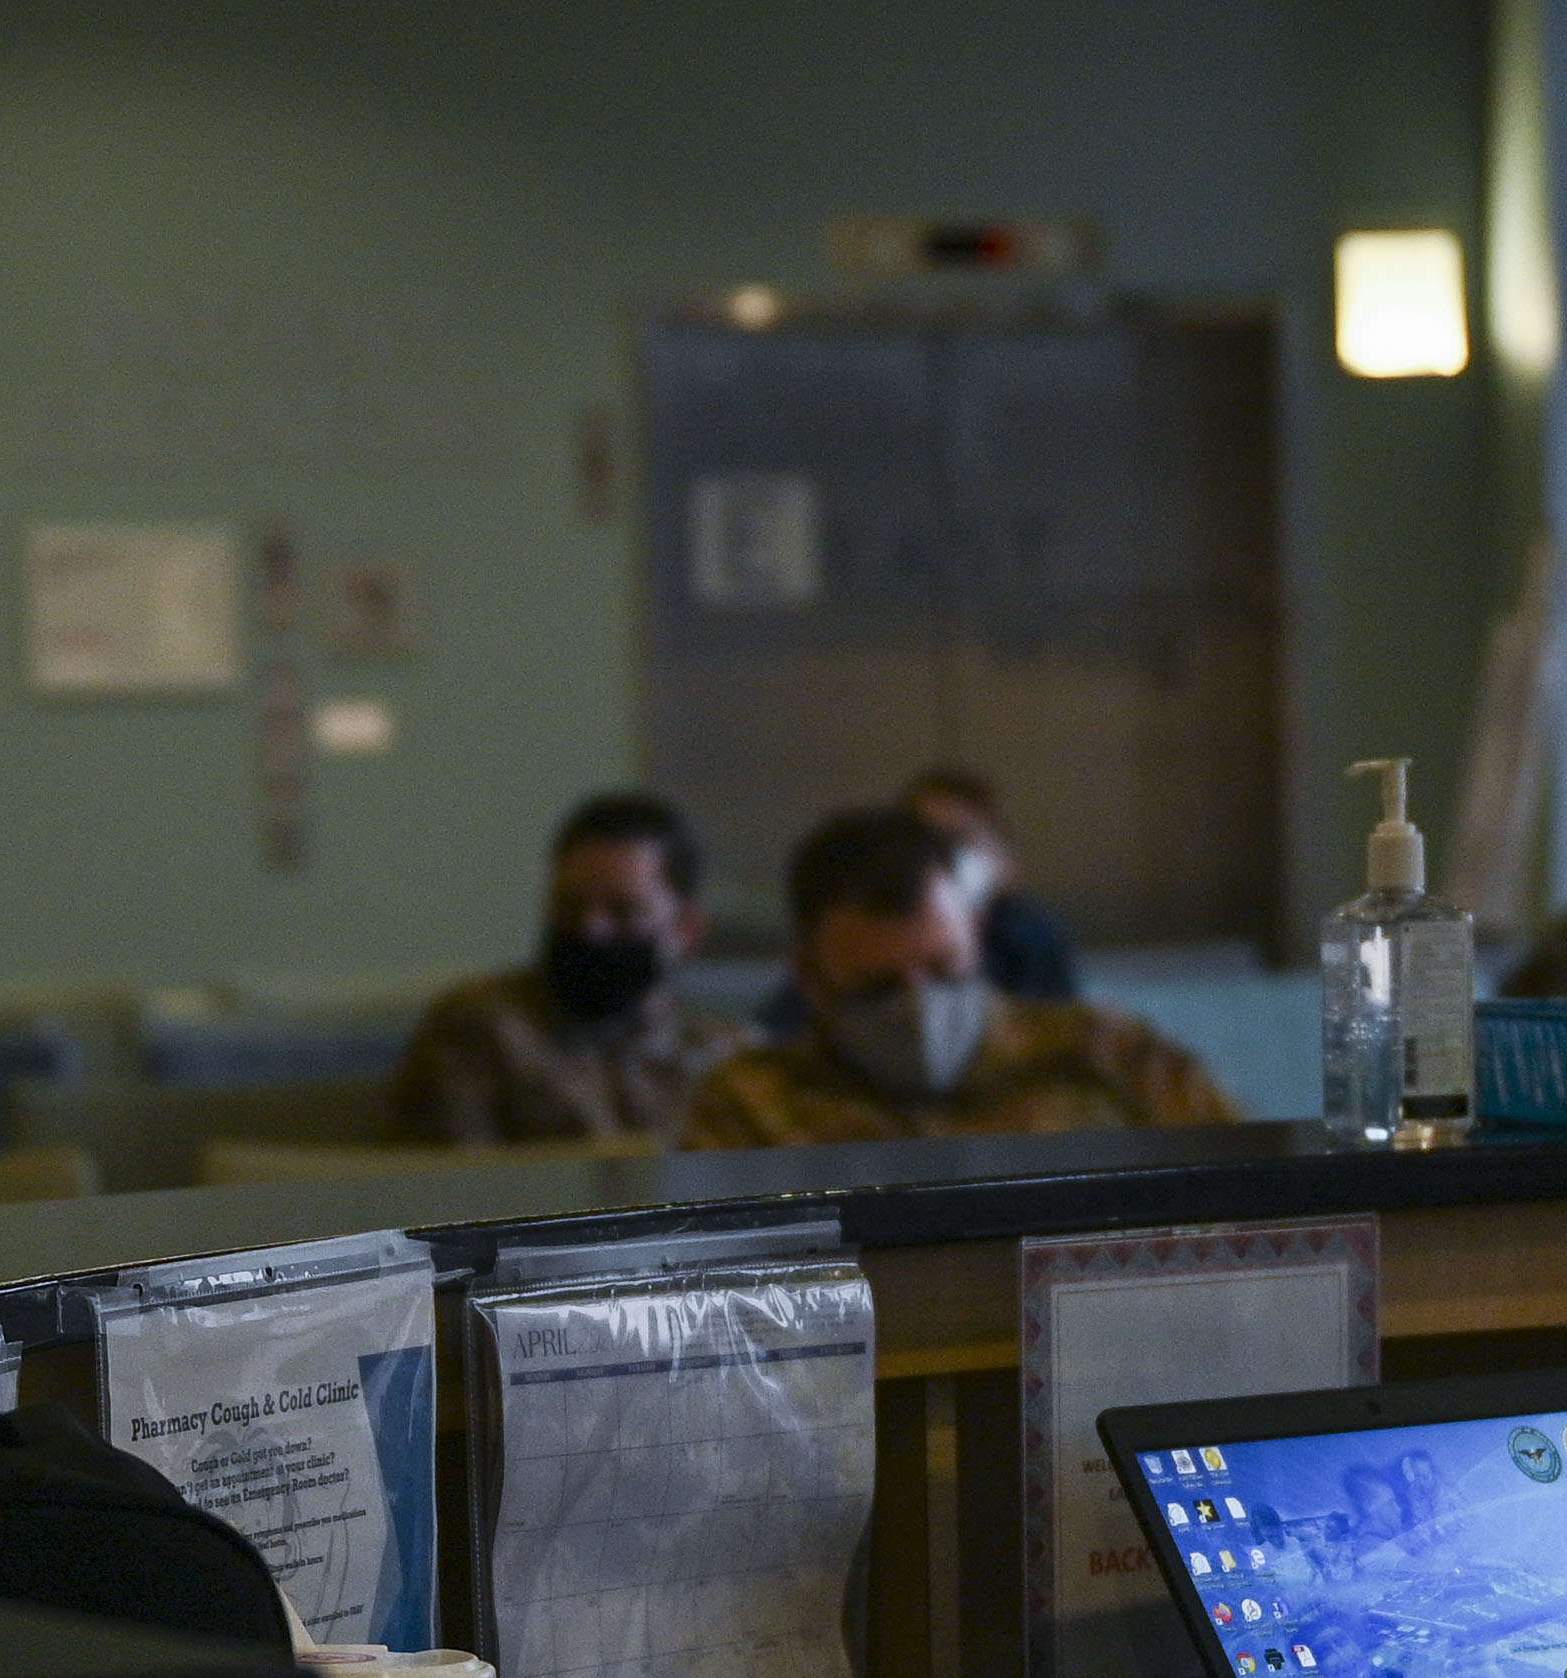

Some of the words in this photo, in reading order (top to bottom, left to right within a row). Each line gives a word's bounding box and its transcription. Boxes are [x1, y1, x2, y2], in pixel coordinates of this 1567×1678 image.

[513, 1327, 576, 1359] APRIL
[130, 1411, 208, 1441] Pharmacy
[211, 1397, 260, 1427] Cough
[263, 1393, 275, 1415] &
[279, 1386, 312, 1413] Cold
[316, 1379, 359, 1406] Clinic
[191, 1455, 219, 1475] Cough
[230, 1449, 251, 1465] Cold
[253, 1447, 266, 1464] got
[268, 1446, 283, 1461] you
[284, 1437, 312, 1455] down?
[195, 1478, 208, 1496] get
[222, 1466, 274, 1490] appointment
[286, 1459, 305, 1478] your
[306, 1451, 335, 1470] clinic?
[215, 1496, 230, 1509] see
[243, 1481, 291, 1502] Emergency
[292, 1477, 317, 1492] Room
[318, 1468, 350, 1487] doctor?
